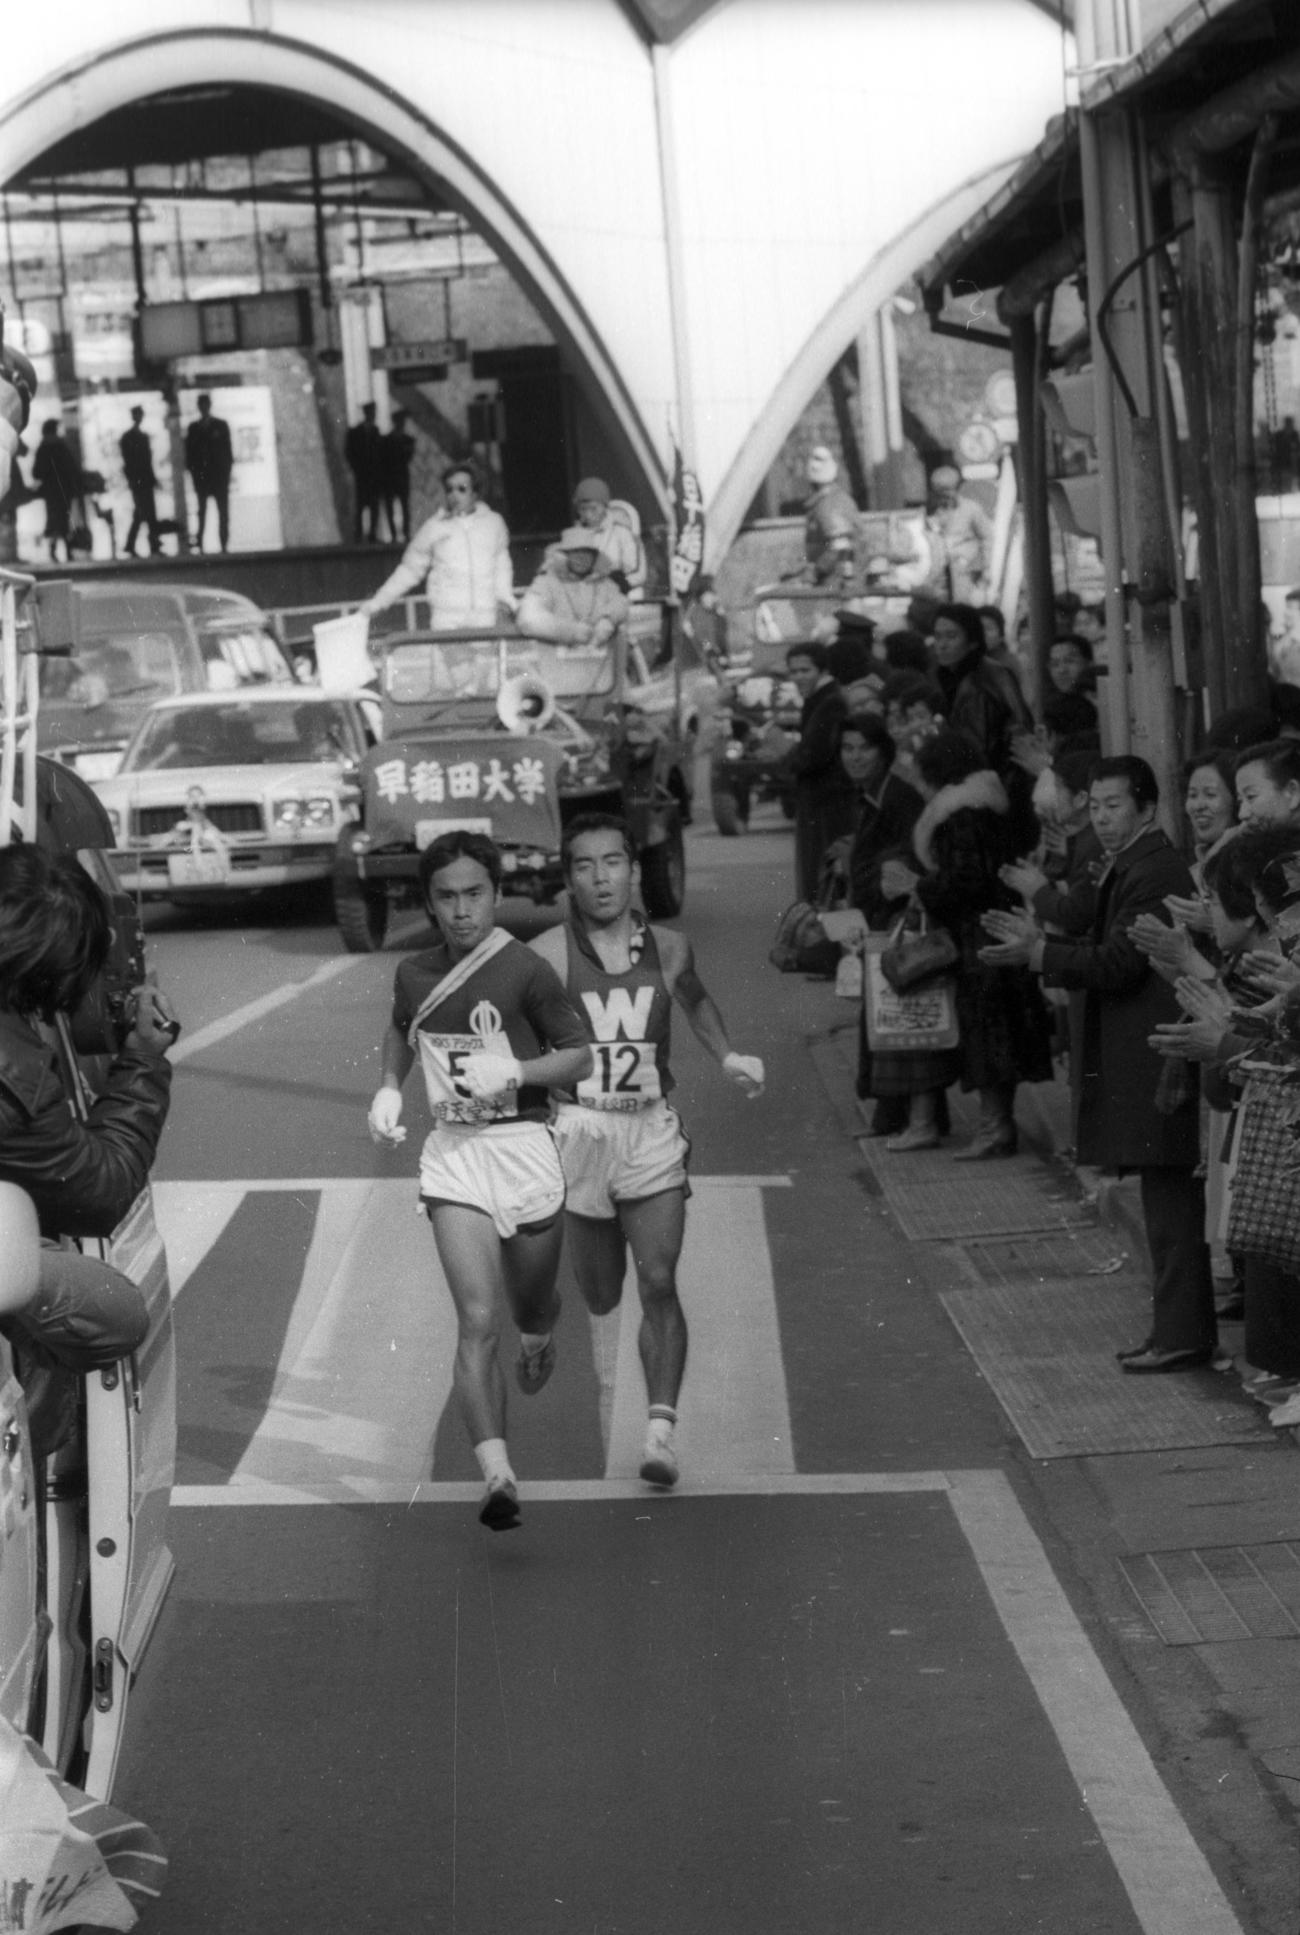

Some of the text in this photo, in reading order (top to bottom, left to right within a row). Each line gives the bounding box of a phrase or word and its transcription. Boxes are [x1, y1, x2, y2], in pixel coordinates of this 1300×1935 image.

[374, 757, 546, 805] 早稲田大学
[580, 986, 655, 1041] W
[597, 1045, 642, 1094] 12
